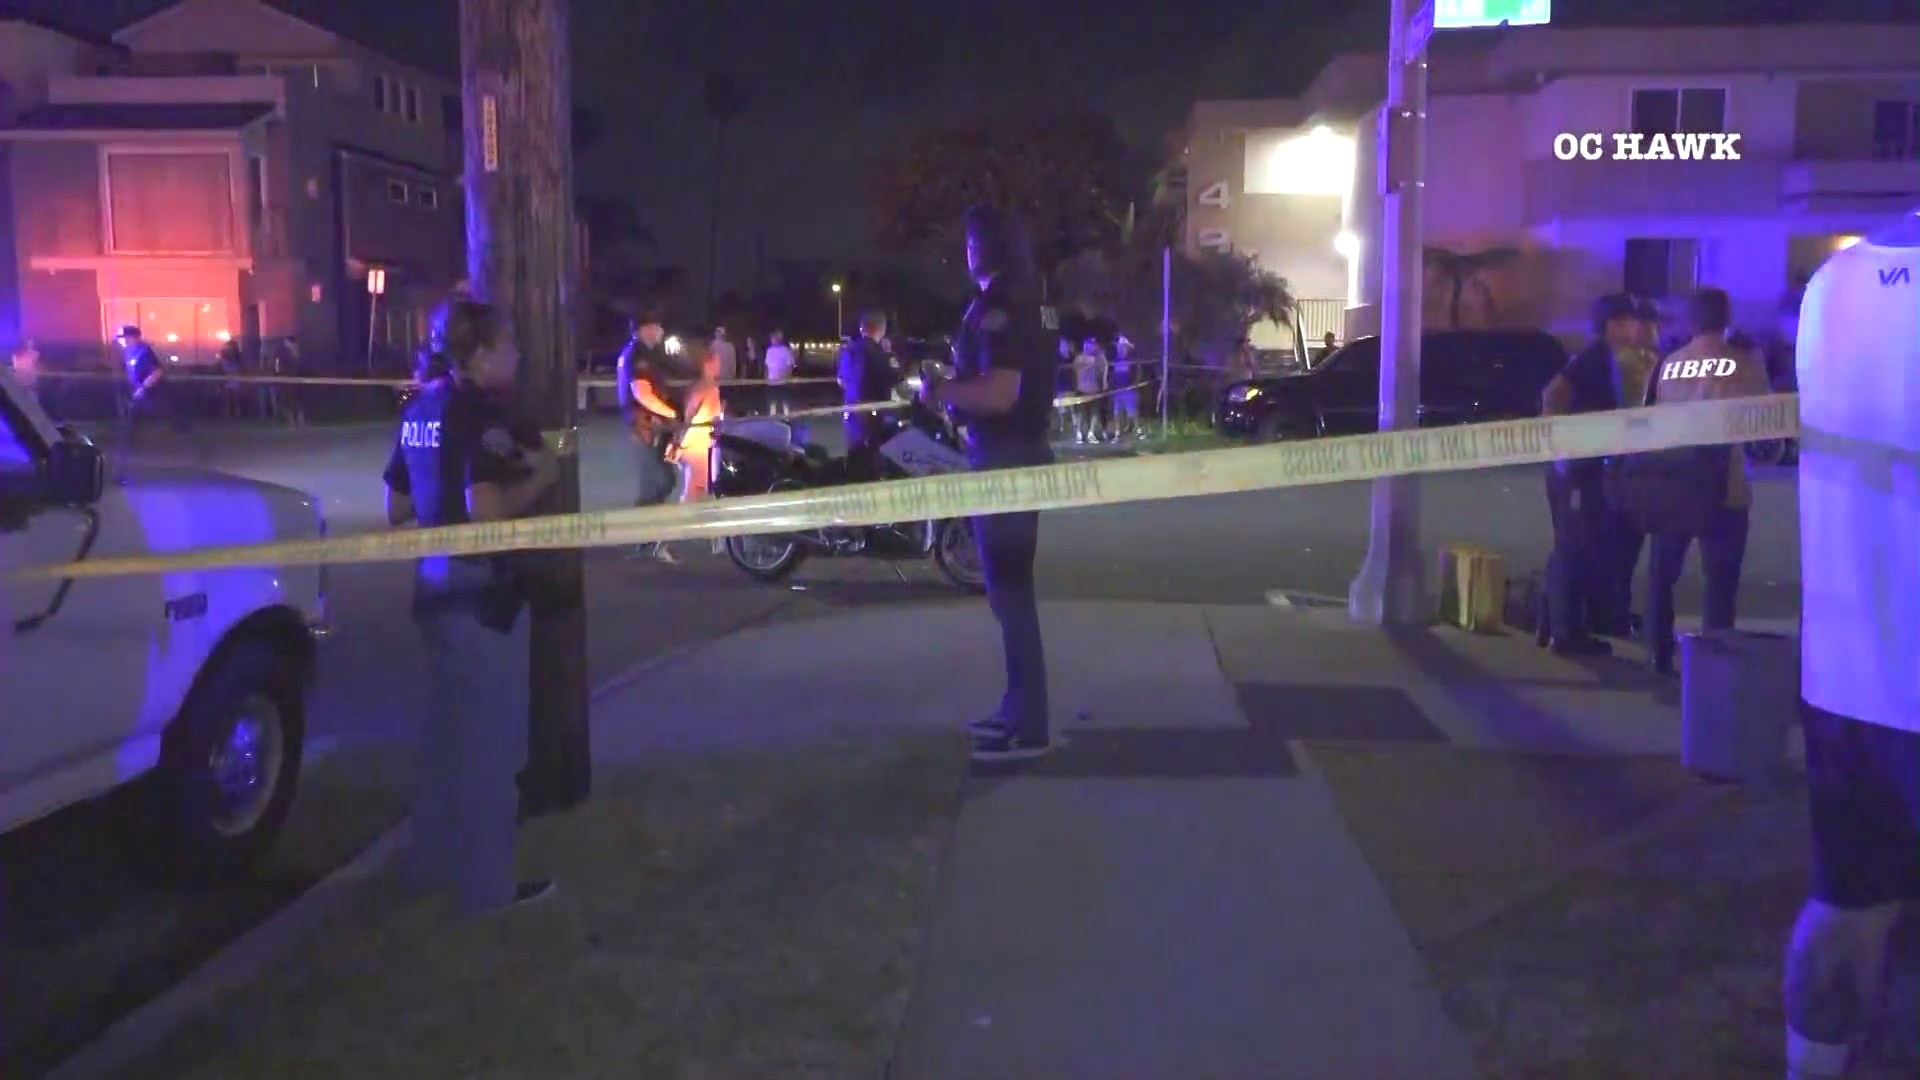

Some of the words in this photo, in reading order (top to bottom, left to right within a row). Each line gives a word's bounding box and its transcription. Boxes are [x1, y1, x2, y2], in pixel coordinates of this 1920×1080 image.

[1199, 180, 1230, 209] 4
[1661, 357, 1737, 380] HBFD
[401, 421, 441, 448] POLICE
